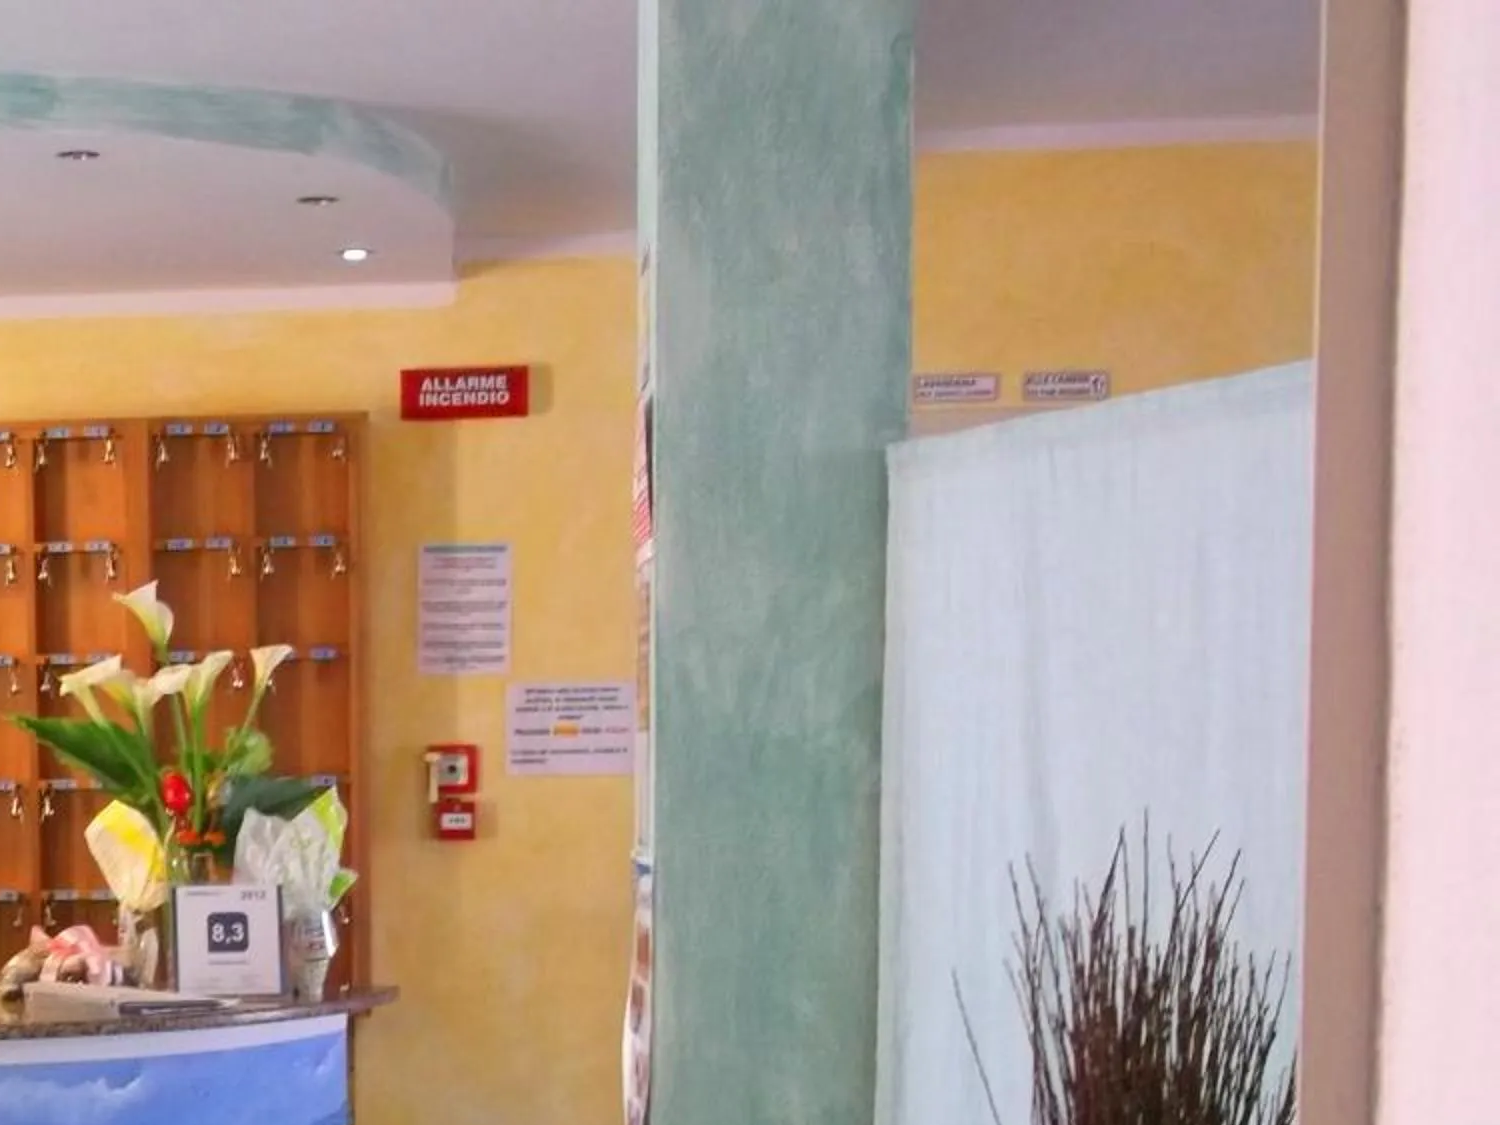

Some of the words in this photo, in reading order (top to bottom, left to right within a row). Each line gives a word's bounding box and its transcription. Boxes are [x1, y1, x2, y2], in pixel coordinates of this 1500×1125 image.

[420, 375, 508, 391] ALLARME
[418, 391, 510, 408] INCENDIO
[211, 921, 245, 945] 8,3
